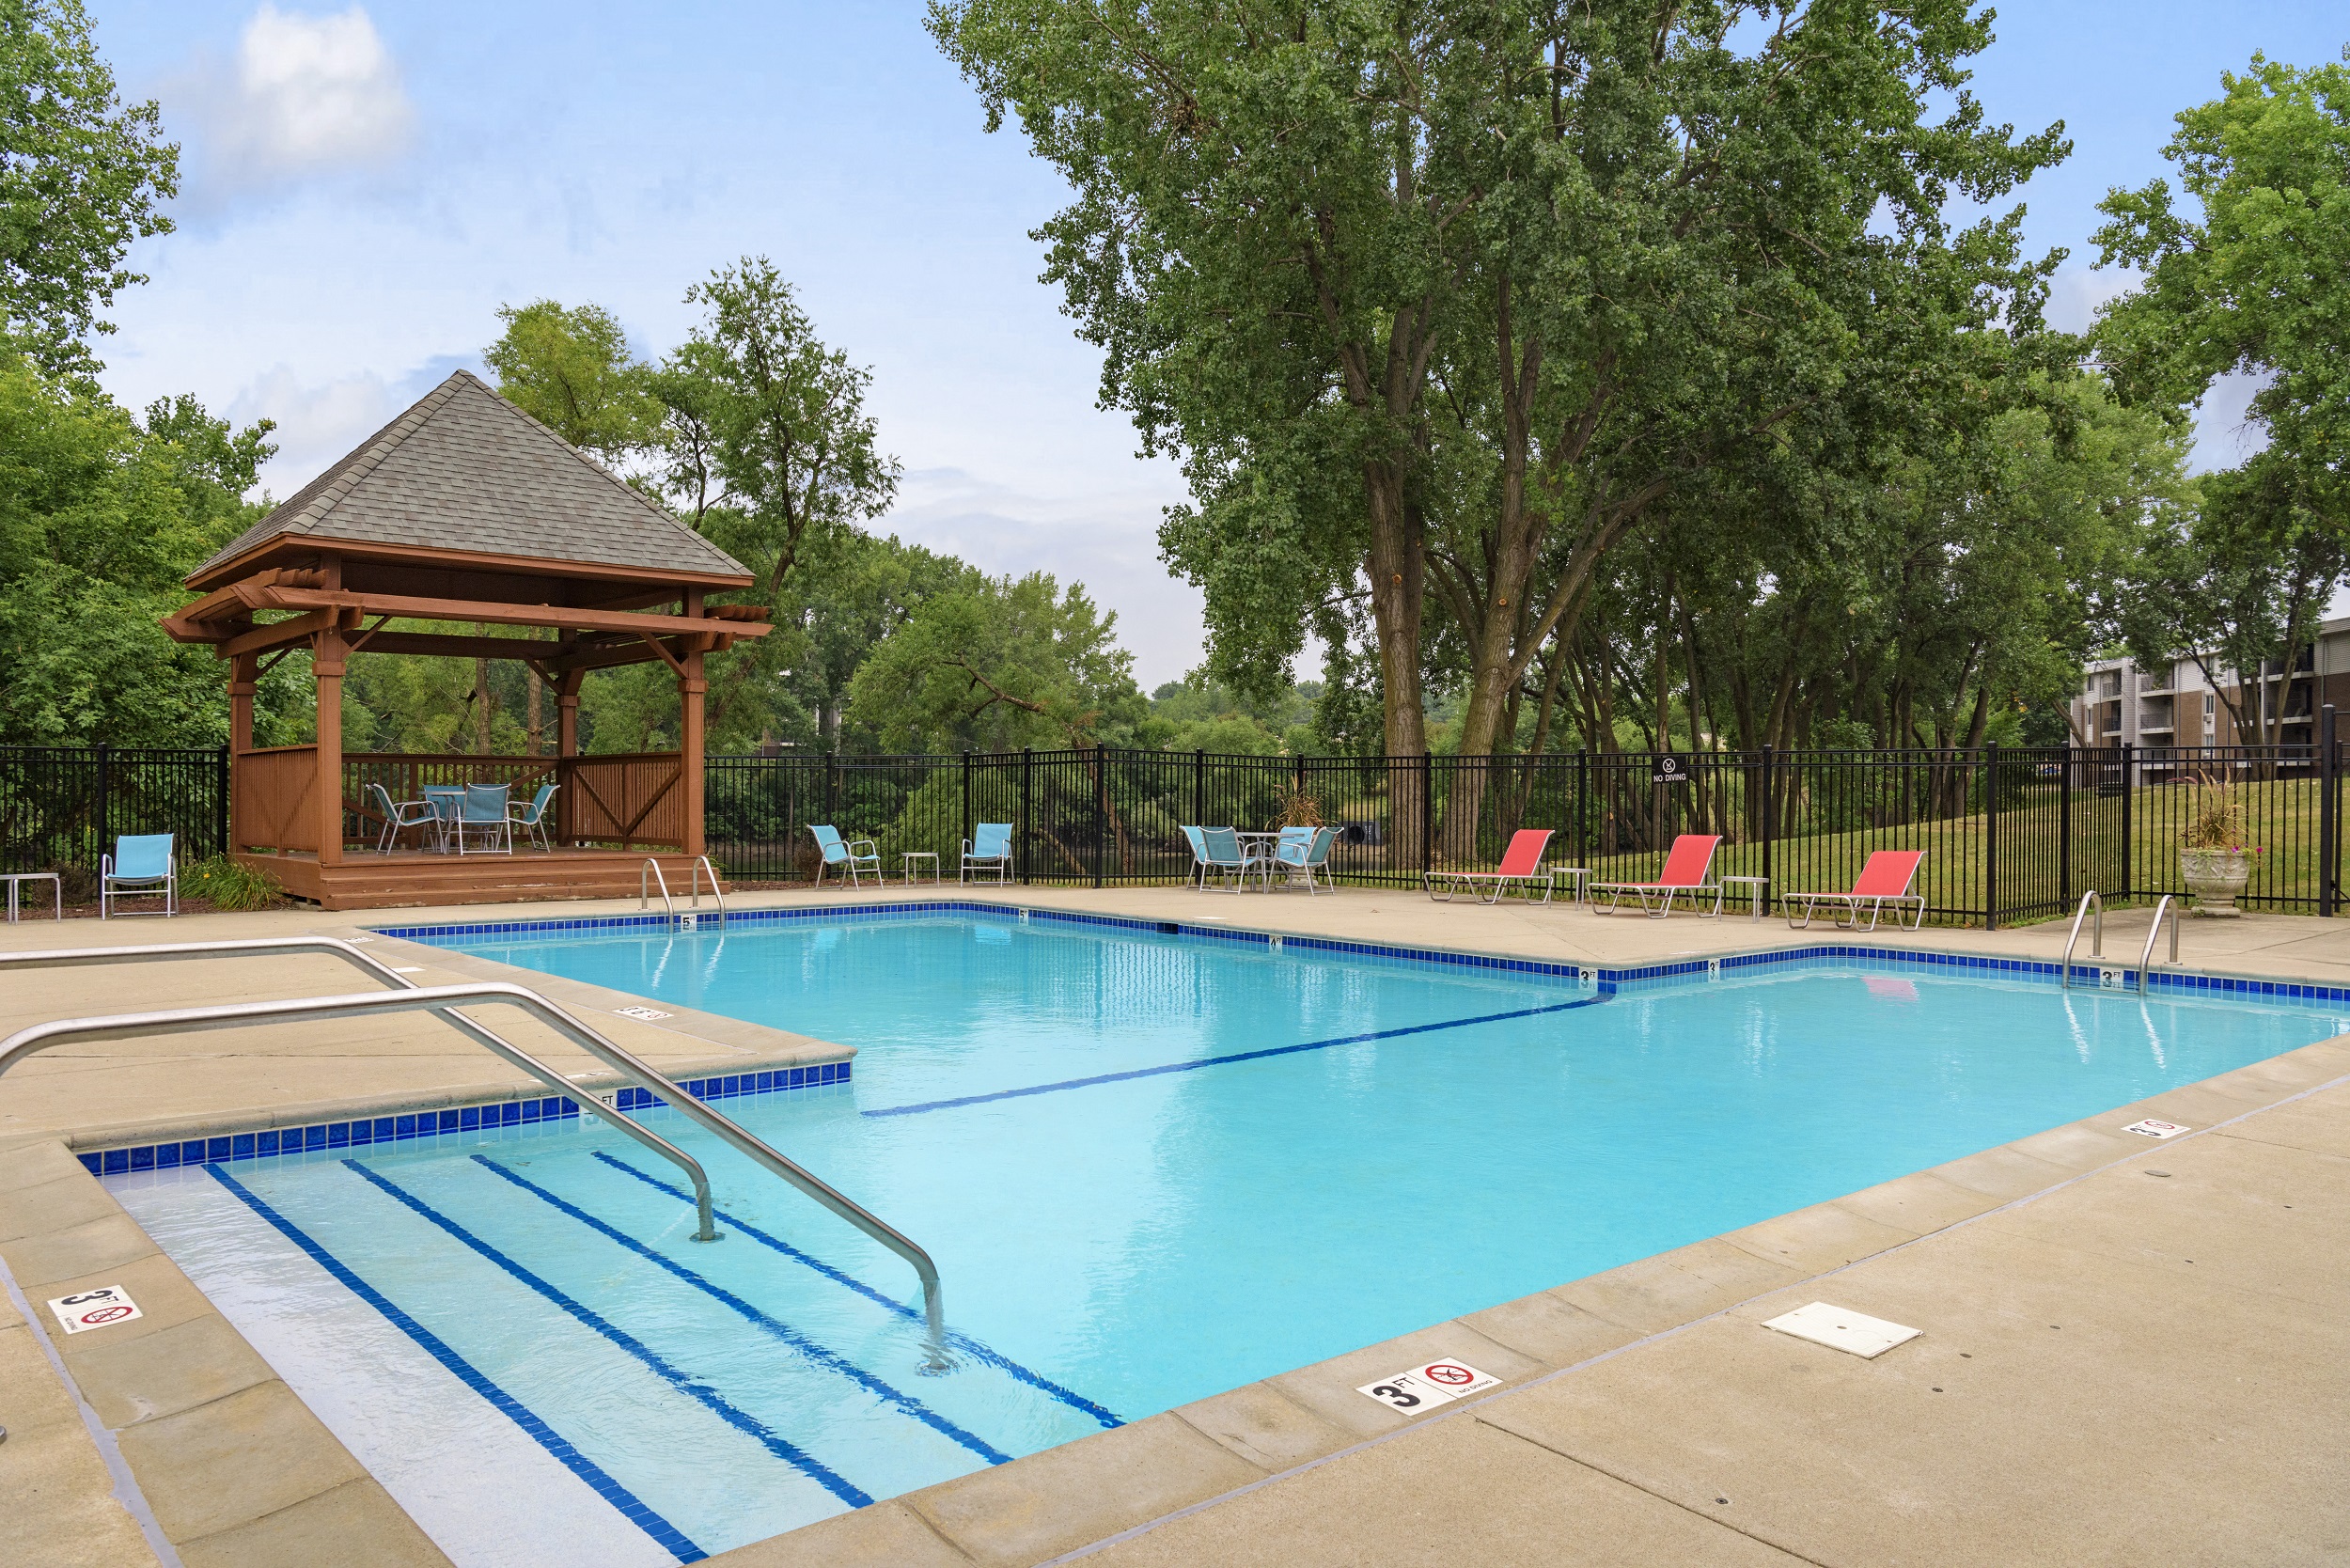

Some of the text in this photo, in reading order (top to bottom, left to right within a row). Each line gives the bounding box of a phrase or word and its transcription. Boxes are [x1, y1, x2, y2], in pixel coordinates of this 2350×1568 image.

[1710, 962, 1716, 972] 3
[1581, 970, 1589, 980] 3
[2102, 971, 2112, 980] 3
[61, 1290, 113, 1305] 3
[1469, 1379, 1493, 1390] DIVING
[1372, 1377, 1420, 1407] 3 FT
